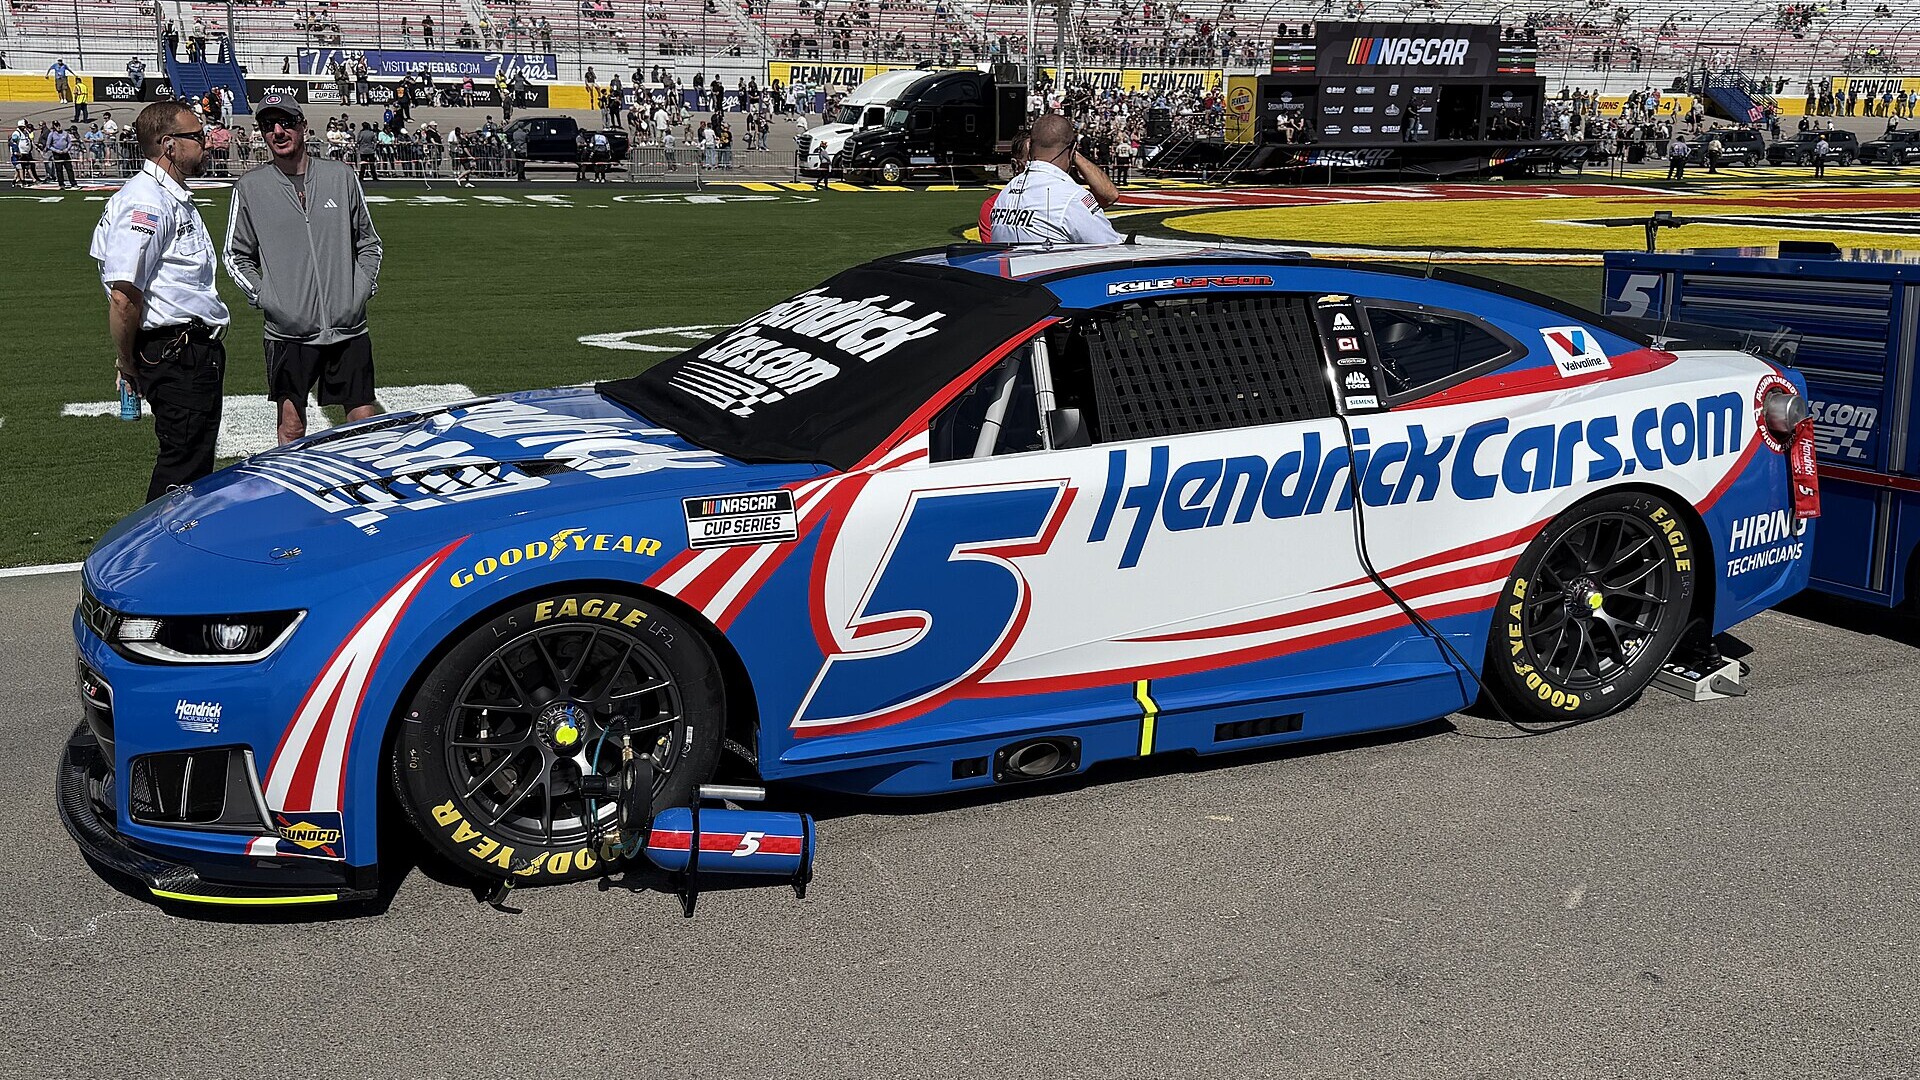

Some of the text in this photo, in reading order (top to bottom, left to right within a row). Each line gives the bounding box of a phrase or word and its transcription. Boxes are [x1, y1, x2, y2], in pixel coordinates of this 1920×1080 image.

[1377, 38, 1469, 65] NASCAR
[106, 86, 135, 96] BUSCH
[263, 85, 299, 97] xfinity
[1141, 73, 1205, 90] PENNZOIL
[368, 90, 394, 99] BUSCH
[461, 89, 490, 98] Feway
[1597, 101, 1619, 110] URNS
[990, 208, 1034, 228] OFFICIAL
[1609, 274, 1661, 317] 5
[726, 286, 947, 363] Hendrick
[1562, 357, 1604, 372] Valvoline
[1345, 371, 1370, 385] MAC
[1799, 484, 1814, 496] 5
[719, 496, 777, 514] NASCAR
[703, 516, 781, 537] CUP SERIES
[1729, 507, 1807, 553] HIRING
[1648, 506, 1691, 572] EAGLE
[1726, 542, 1804, 578] TECHNICIANS
[533, 598, 648, 629] EAGLE
[789, 478, 1075, 732] 5
[175, 699, 222, 719] Hendrick
[182, 715, 220, 724] MOTORSPORTS
[280, 826, 339, 843] SUNOCO
[431, 799, 622, 877] OODYEAR
[731, 831, 766, 857] 5
